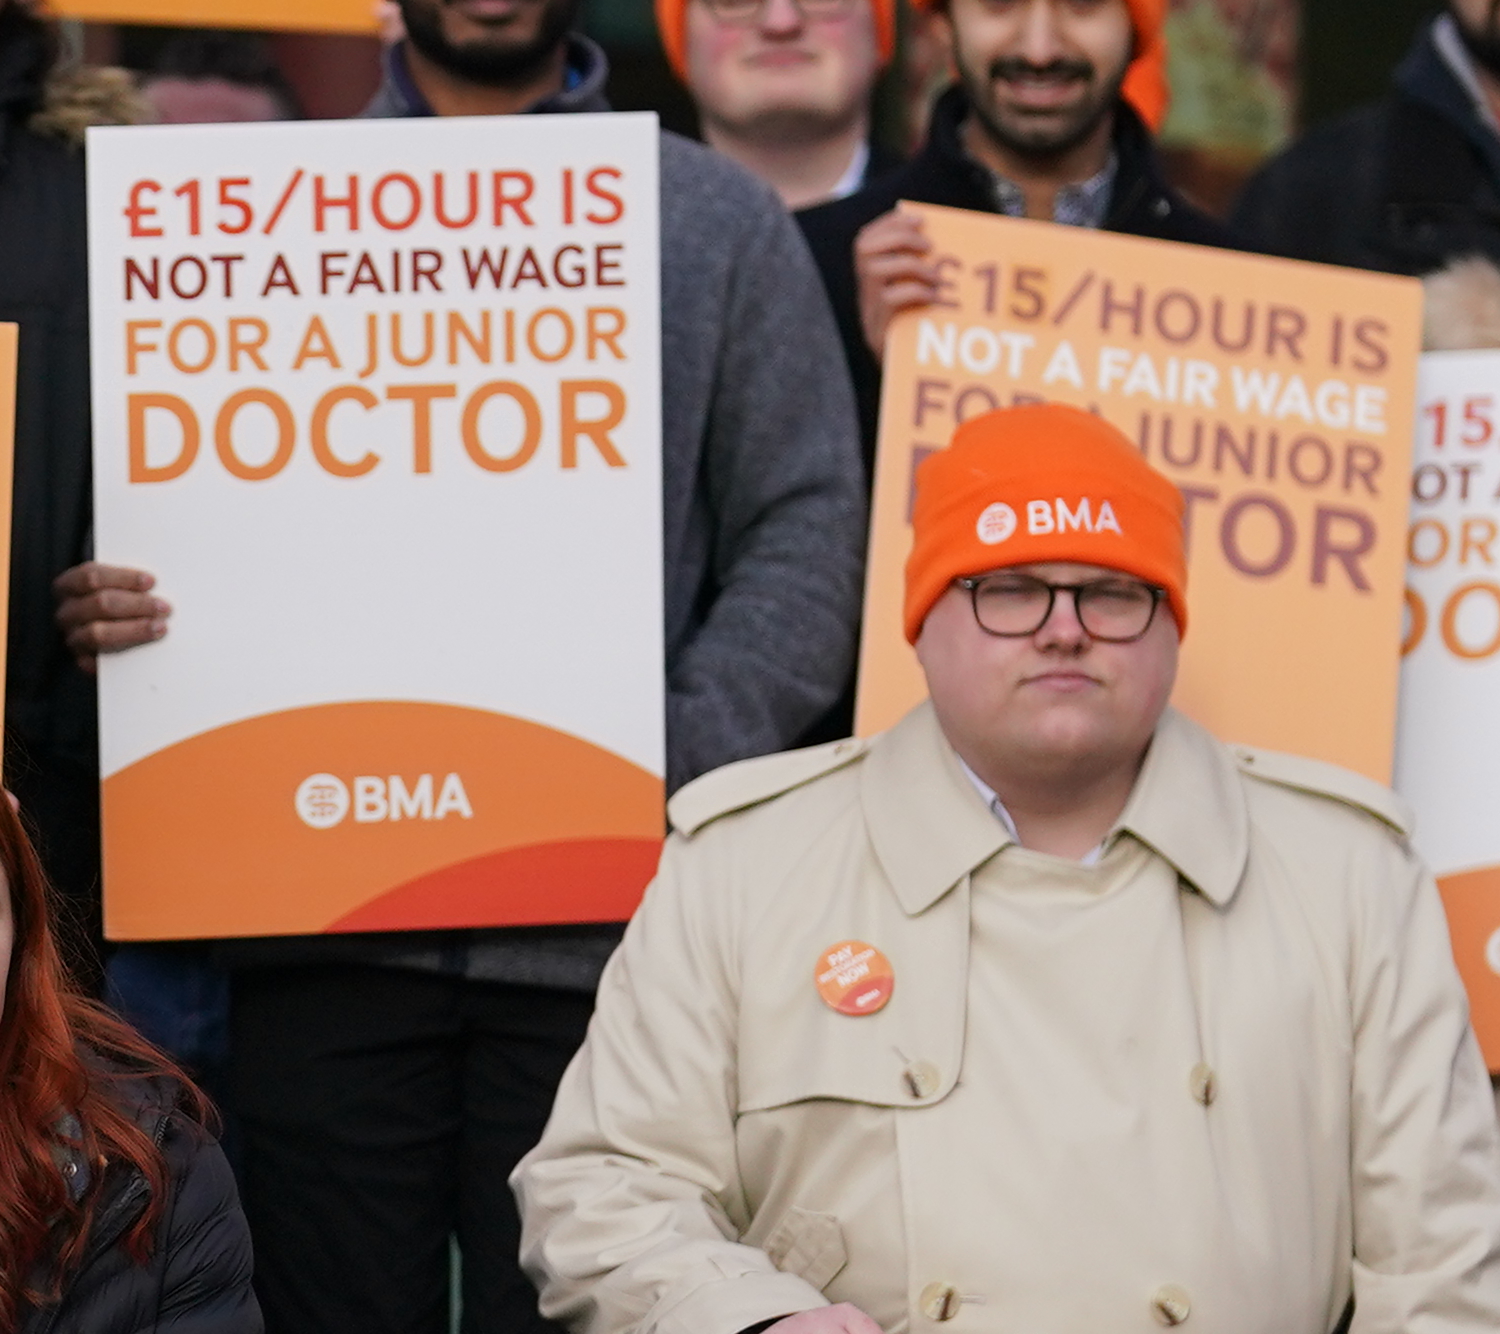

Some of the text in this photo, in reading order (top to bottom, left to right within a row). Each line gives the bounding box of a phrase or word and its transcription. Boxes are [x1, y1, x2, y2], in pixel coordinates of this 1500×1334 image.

[123, 166, 626, 237] £15/HOUR IS
[123, 243, 627, 301] NOT A FAIR WAGE
[124, 306, 629, 379] FOR A JUNIOR
[930, 256, 1390, 376] £15/HOUR IS
[913, 376, 1045, 431] FO
[916, 319, 1388, 435] NOT A FAIR WAGE
[127, 380, 629, 484] DOCTOR
[1412, 461, 1481, 503] OT
[1025, 496, 1123, 537] BMA
[1407, 517, 1499, 568] OR
[354, 773, 473, 824] BMA
